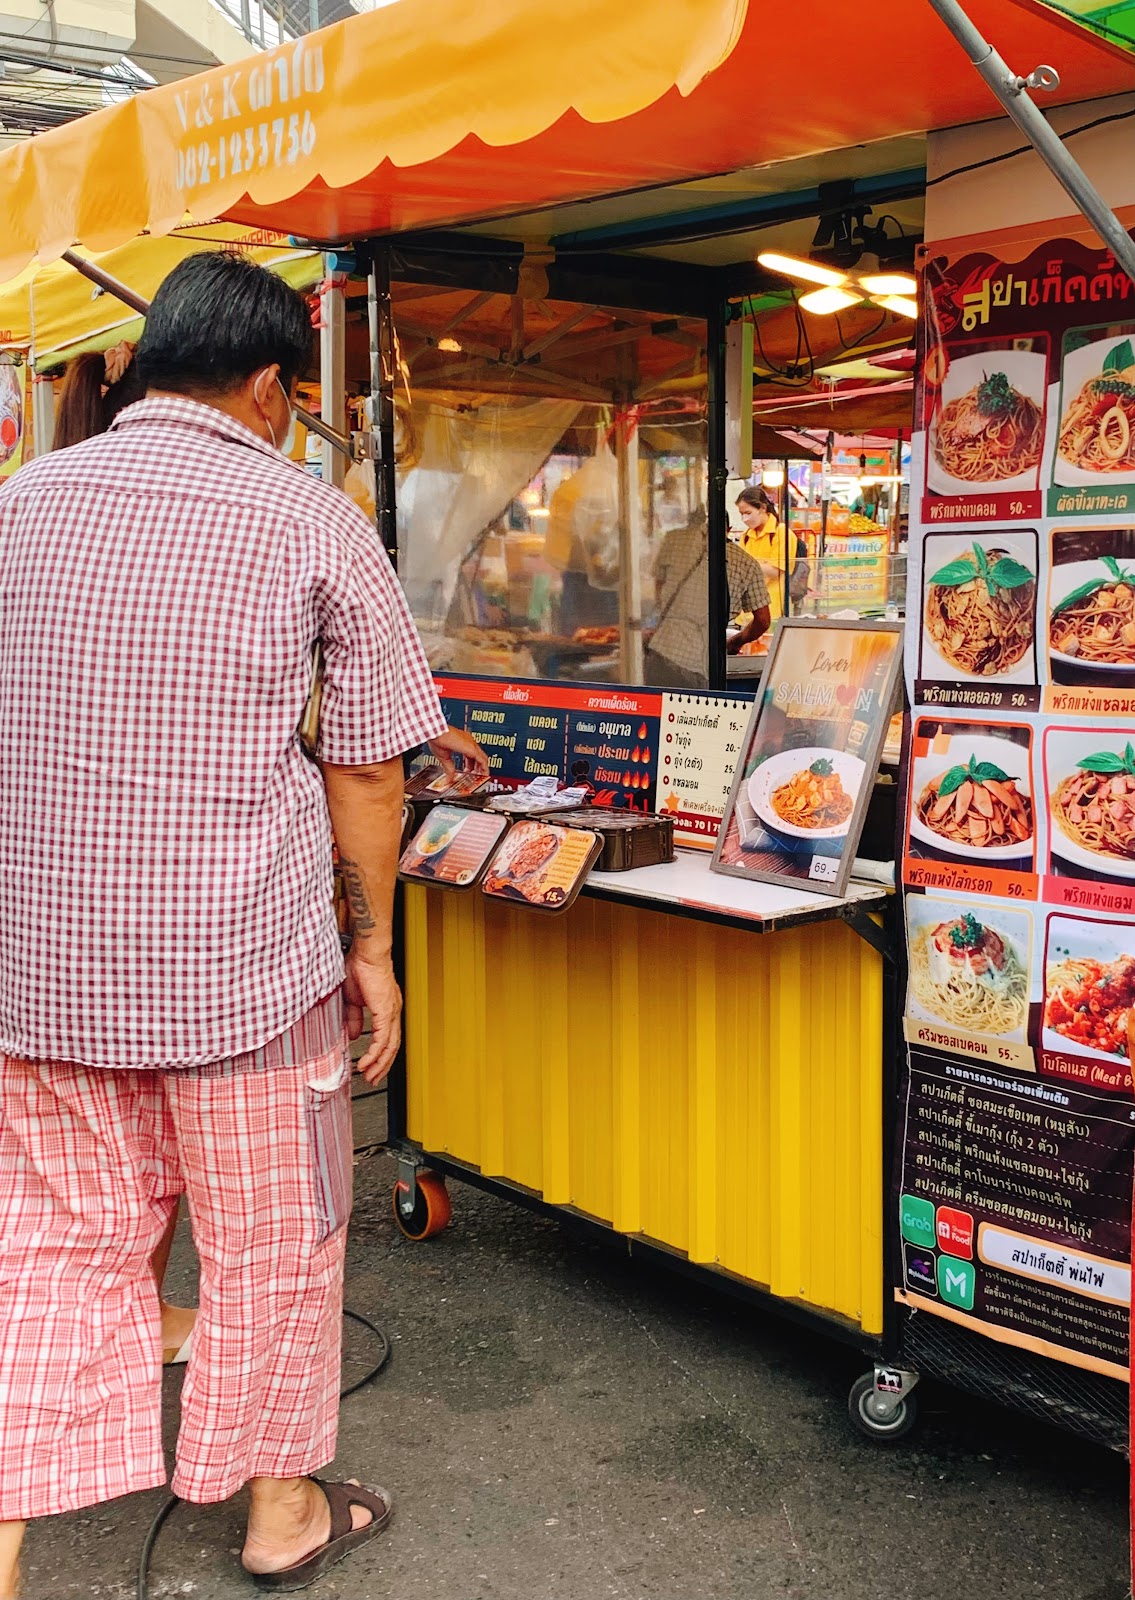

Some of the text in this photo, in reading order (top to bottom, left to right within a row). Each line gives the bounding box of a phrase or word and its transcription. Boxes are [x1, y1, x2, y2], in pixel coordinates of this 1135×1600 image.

[175, 89, 189, 132] V
[195, 83, 213, 128] &
[222, 71, 242, 120] K
[930, 497, 1033, 519] พริกแห้งเบคอน 50.-
[1056, 488, 1128, 512] ผัดขี้เมาทะเล
[810, 651, 852, 674] Lover
[503, 684, 530, 702] เนื้อสัตว์
[588, 695, 639, 711] ความเผ็ดร้อน
[923, 683, 1035, 707] พริกแห้งหอยลาย 50.-
[471, 709, 558, 730] หอยลาย เบคอน
[676, 711, 743, 731] เส้นสปาเก็ตตี้ 15.-
[599, 722, 632, 740] อนุบาล
[526, 738, 546, 751] แฮม
[598, 743, 631, 761] ประถม
[524, 756, 559, 776] ไส้กรอก
[674, 752, 703, 771] กุ้ง (2ตัว)
[594, 766, 622, 784] มัธยม
[672, 777, 699, 790] แซลมอน
[694, 820, 706, 831] 70
[813, 862, 839, 876] 69.-
[908, 867, 1033, 897] พริกแห้งไส้กรอก 50.-
[1063, 885, 1132, 911] พริกแห้งแฮม
[918, 1027, 1020, 1061] ครีมซอสเบคอน 55.-
[1042, 1053, 1088, 1078] โบโลเนส
[1090, 1065, 1122, 1086] (Meat
[945, 1065, 1070, 1106] รายการความอร่อยเพิ่มเติม
[921, 1082, 1090, 1138] สปาเก็ตตี้ ซอสมะเขือเทศ (หมูสับ)
[918, 1105, 1060, 1156] สปาเก็ตตี้ ขี้เมากุ้ง (กุ้ง 2 ตัว)
[916, 1153, 962, 1177] สปาเก็ตตี้
[918, 1129, 1090, 1193] สปาเก็ตตี้ พริกแห้งแซลมอน+ไข่กุ้ง
[914, 1177, 1093, 1241] สปาเก็ตตี้ ครีมซอสแซลมอน+ไข่กุ้ง
[903, 1212, 932, 1233] Grab
[951, 1233, 971, 1246] Food
[1011, 1248, 1105, 1288] สปาเก็ตตี้ พ่นไฟ
